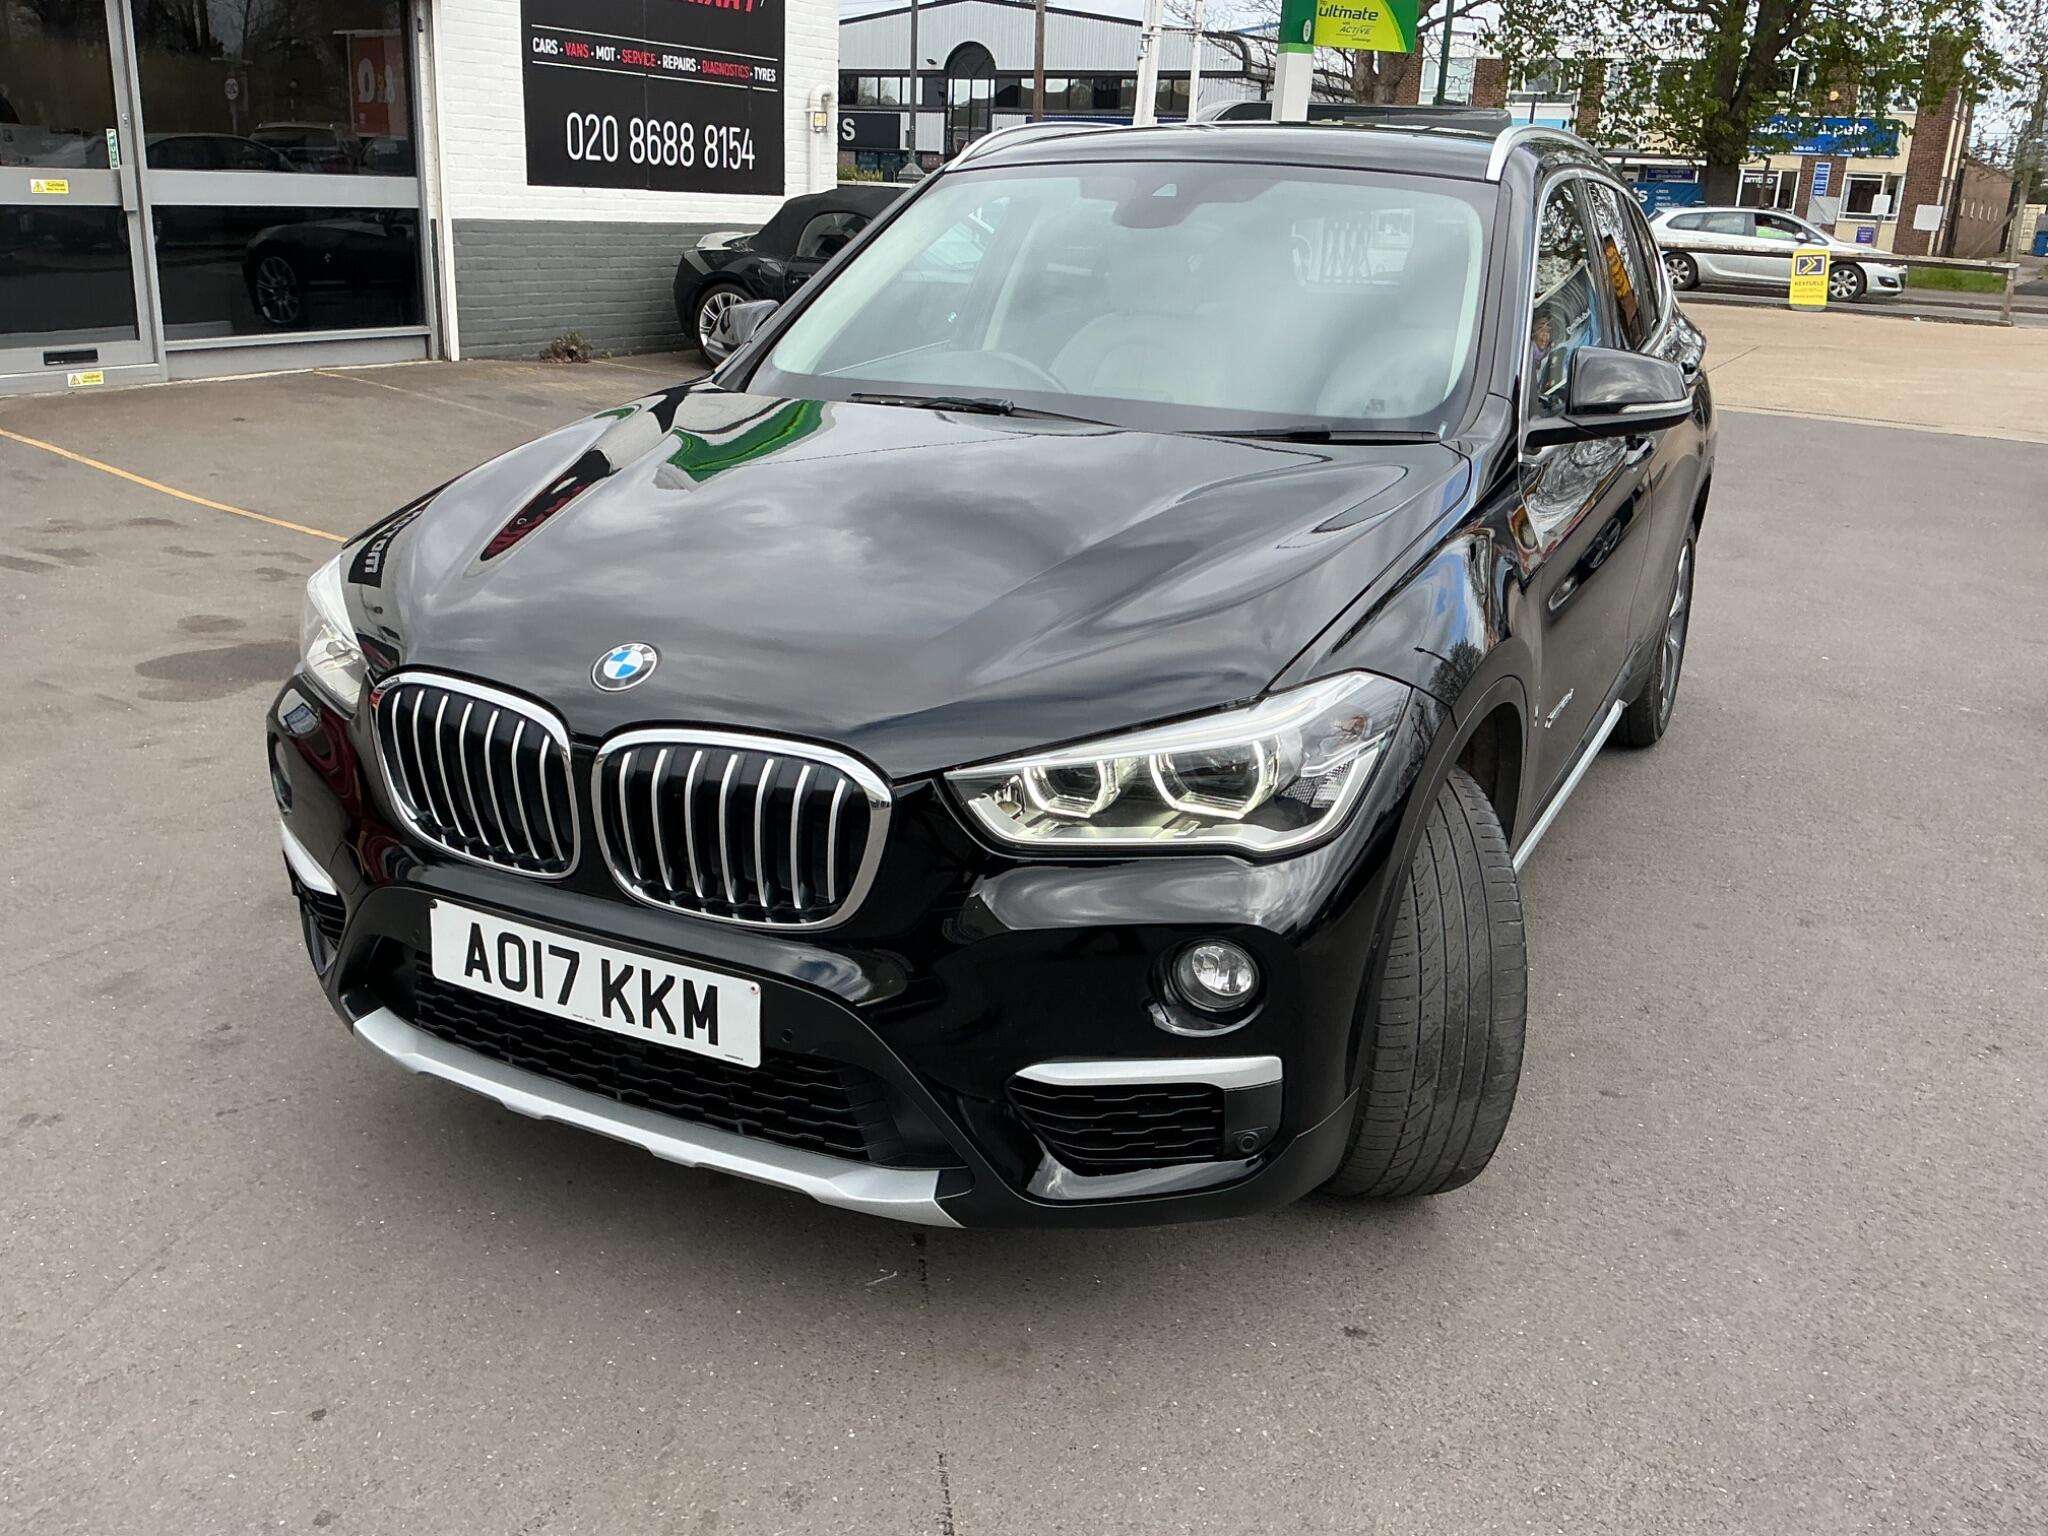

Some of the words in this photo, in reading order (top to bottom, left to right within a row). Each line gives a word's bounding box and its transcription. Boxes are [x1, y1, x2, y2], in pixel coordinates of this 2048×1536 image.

[1340, 26, 1371, 36] ACTIVE
[532, 37, 558, 56] CARS
[564, 41, 589, 59] VANS
[596, 45, 616, 62] MOT
[621, 49, 656, 68] SERVICE
[662, 54, 697, 73] REPAIRS
[702, 59, 749, 79] DIAGNOSTICS
[754, 66, 776, 82] TYRES
[566, 112, 619, 162] 020
[629, 117, 695, 167] 8688
[704, 124, 755, 170] 8154
[463, 922, 580, 1006] AO17
[601, 958, 719, 1046] KKM
